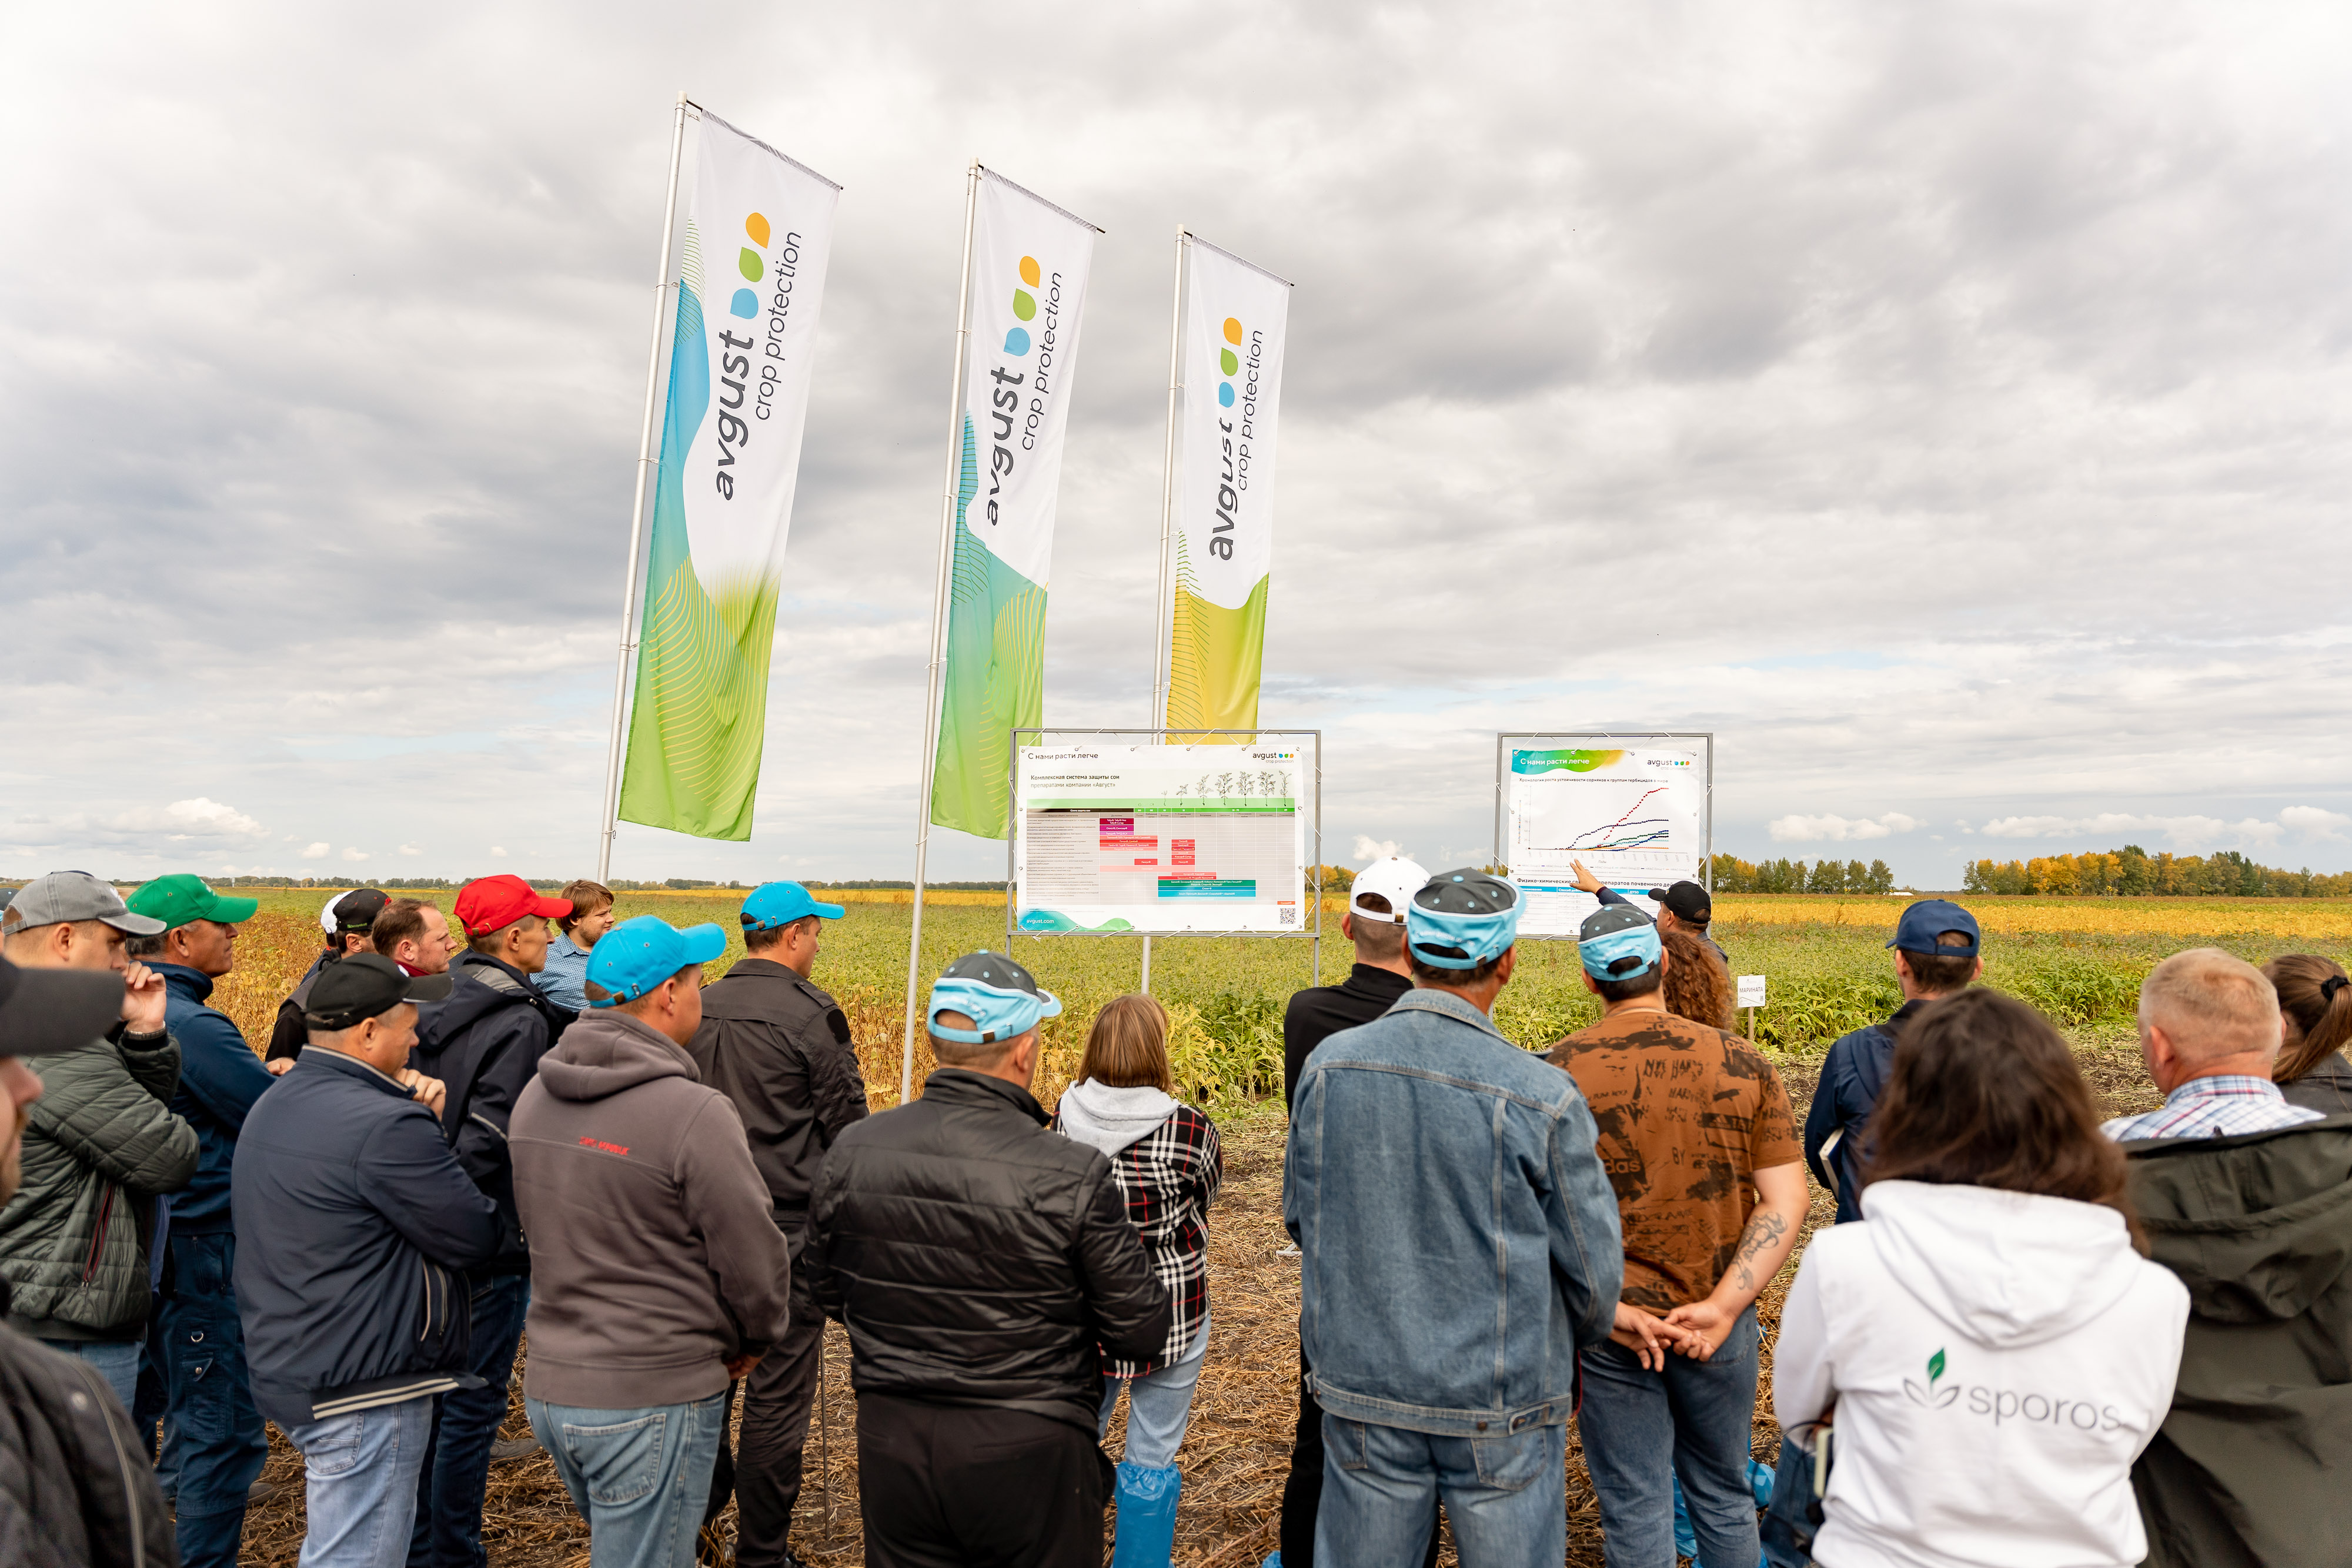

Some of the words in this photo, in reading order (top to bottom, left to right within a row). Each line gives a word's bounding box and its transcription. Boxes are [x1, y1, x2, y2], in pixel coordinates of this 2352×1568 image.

[766, 232, 801, 360] protection
[716, 329, 754, 501] avgust
[756, 365, 781, 420] crop
[1022, 398, 1044, 450] crop
[1034, 272, 1062, 394] protection
[1242, 330, 1262, 440] protection
[987, 366, 1024, 526] avgust
[1209, 417, 1238, 561] avgust
[1238, 444, 1252, 491] crop
[1647, 759, 1672, 767] avgust
[1605, 1159, 1642, 1172] das
[1969, 1386, 2122, 1432] sporos
